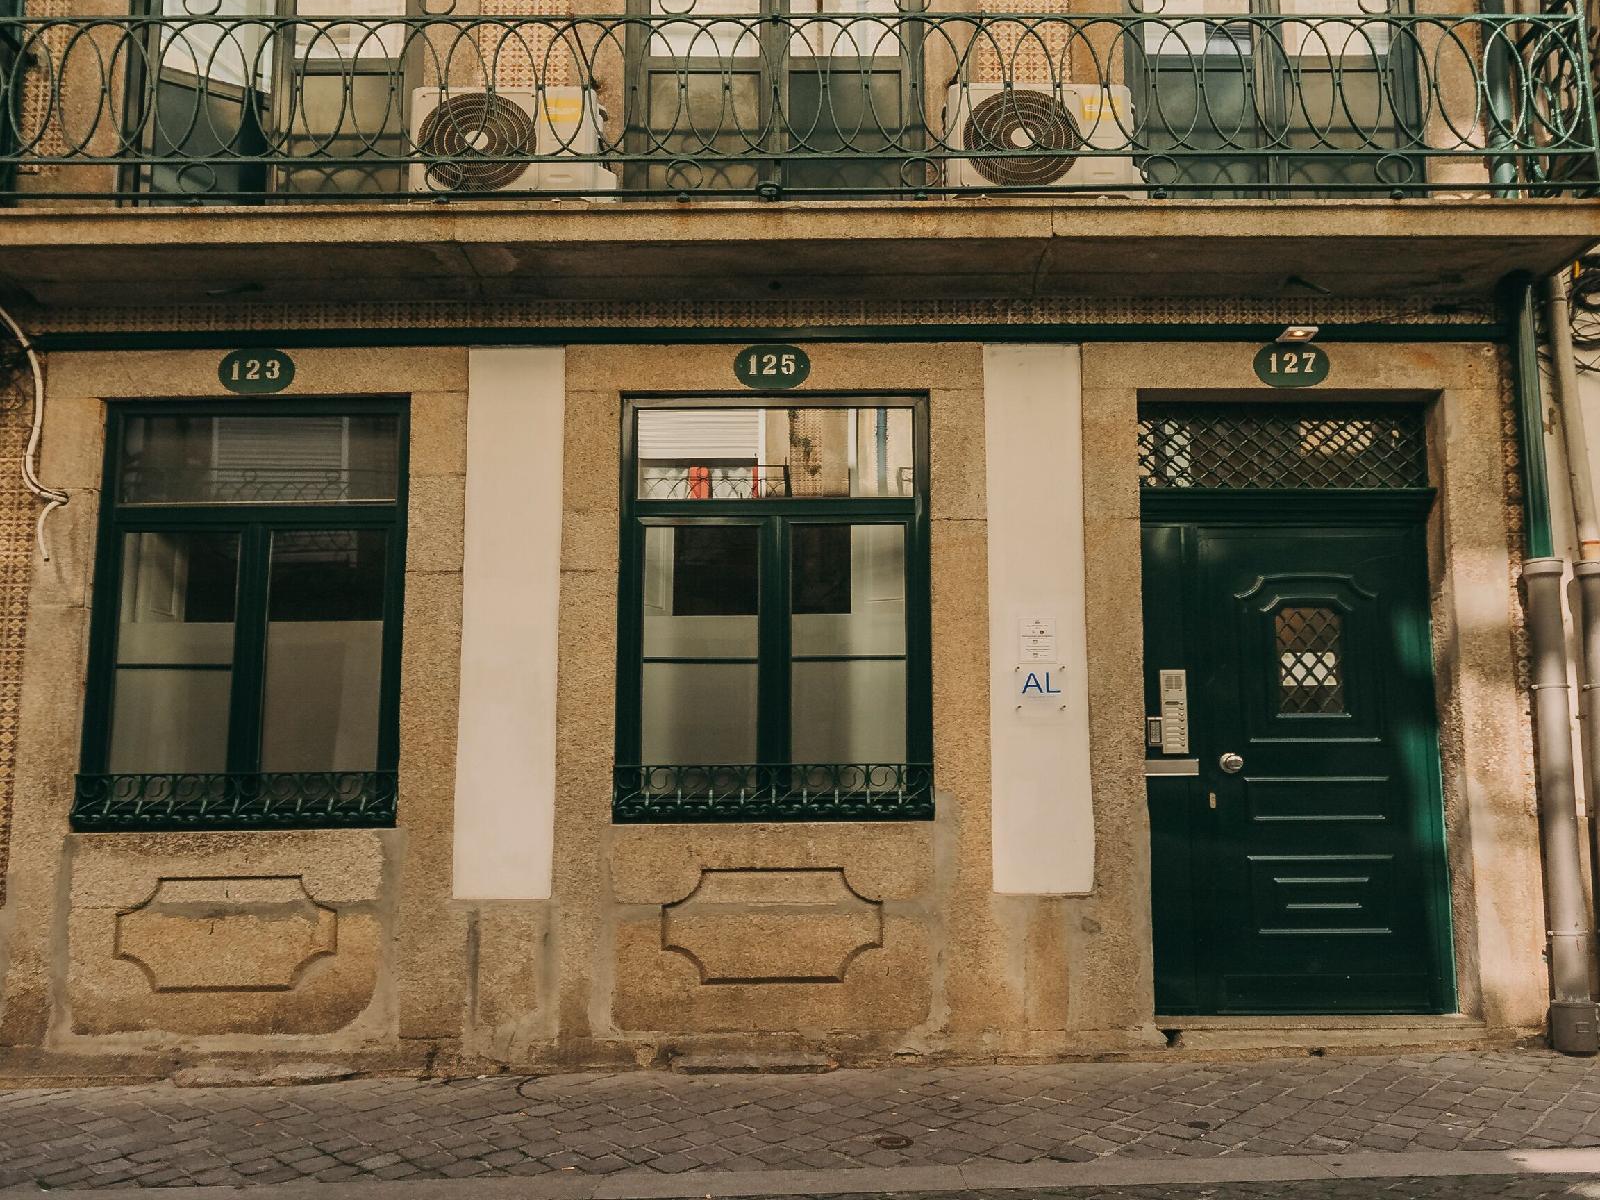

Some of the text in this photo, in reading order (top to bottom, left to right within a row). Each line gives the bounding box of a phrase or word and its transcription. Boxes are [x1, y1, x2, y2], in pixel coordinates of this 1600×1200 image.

[231, 359, 280, 380] 123
[748, 354, 796, 375] 125
[1269, 352, 1316, 374] 127
[1021, 671, 1062, 694] AL
